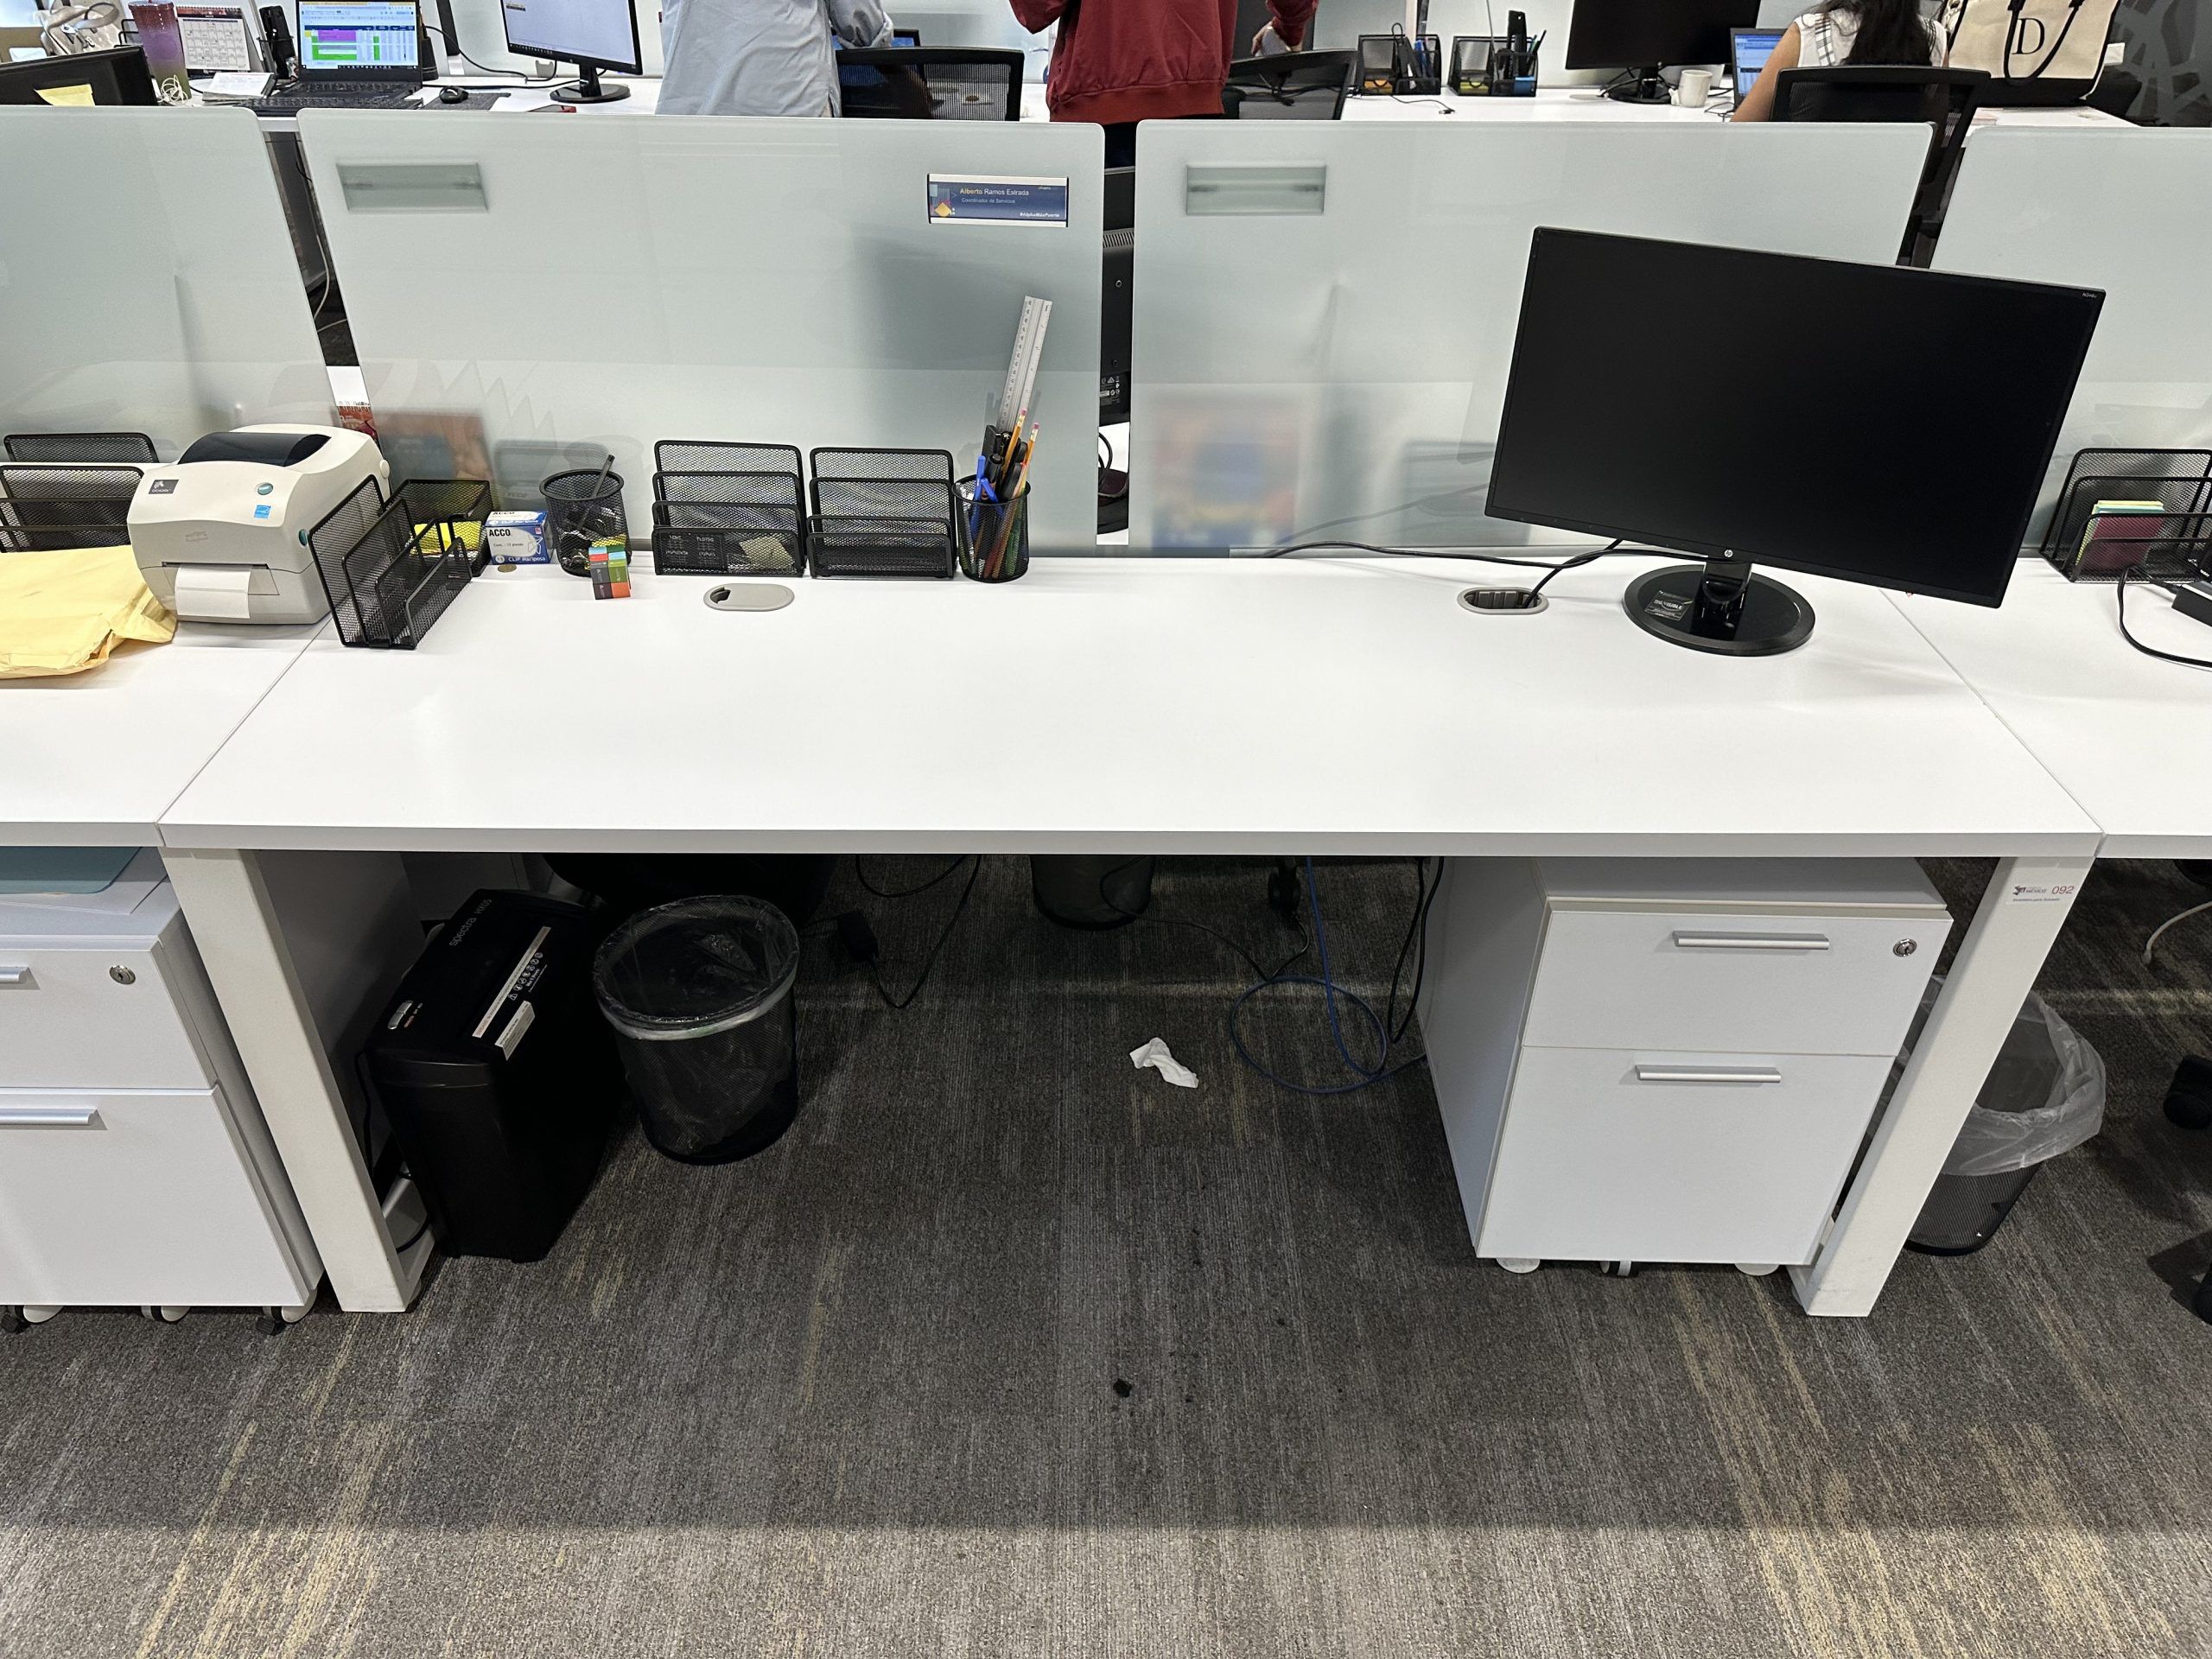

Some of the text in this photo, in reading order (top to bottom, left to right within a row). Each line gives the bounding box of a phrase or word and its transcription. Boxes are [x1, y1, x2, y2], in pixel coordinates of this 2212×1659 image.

[2012, 17, 2045, 55] D
[983, 188, 1005, 196] Ramos
[1006, 188, 1029, 197] Estrada
[2051, 886, 2074, 894] 092
[448, 917, 476, 947] spectra
